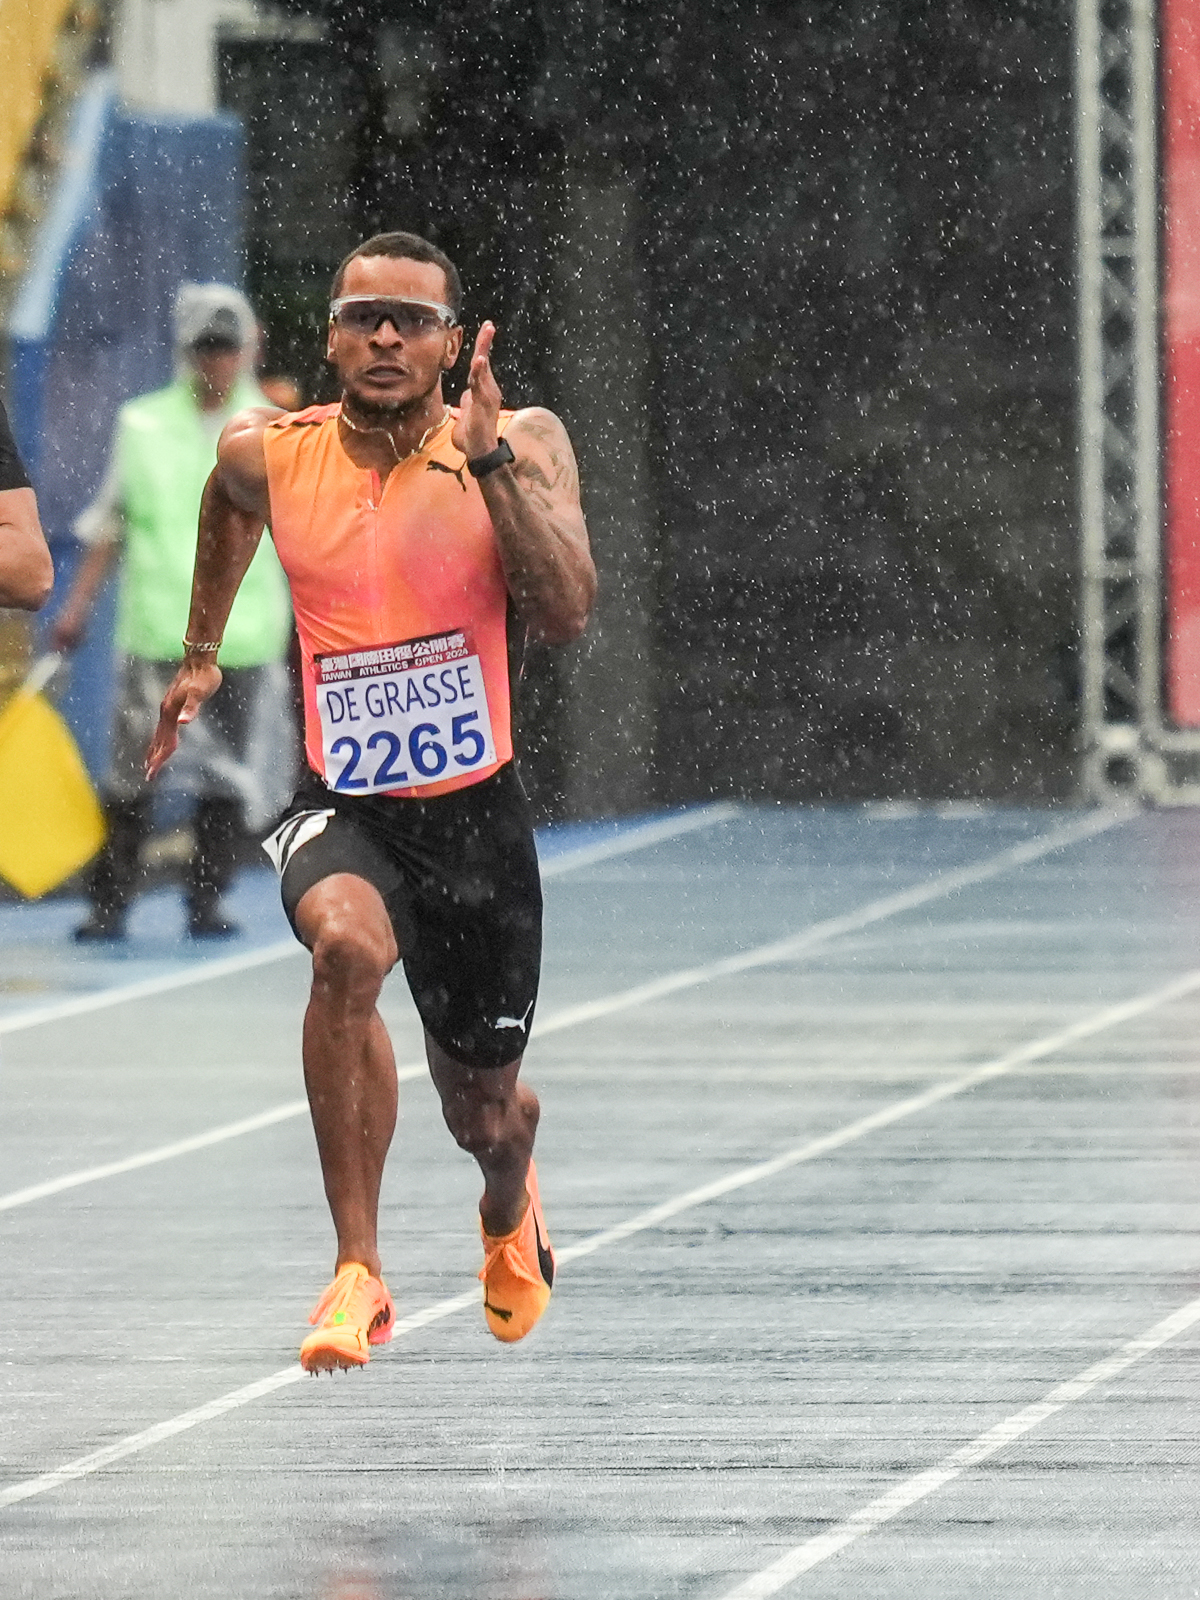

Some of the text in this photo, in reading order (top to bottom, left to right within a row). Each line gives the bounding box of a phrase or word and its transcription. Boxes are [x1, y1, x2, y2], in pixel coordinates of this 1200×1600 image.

[321, 647, 469, 682] TAIWAN ATHLETICS OPEN 2024
[326, 665, 475, 724] DE GRASSE
[330, 710, 486, 790] 2265
